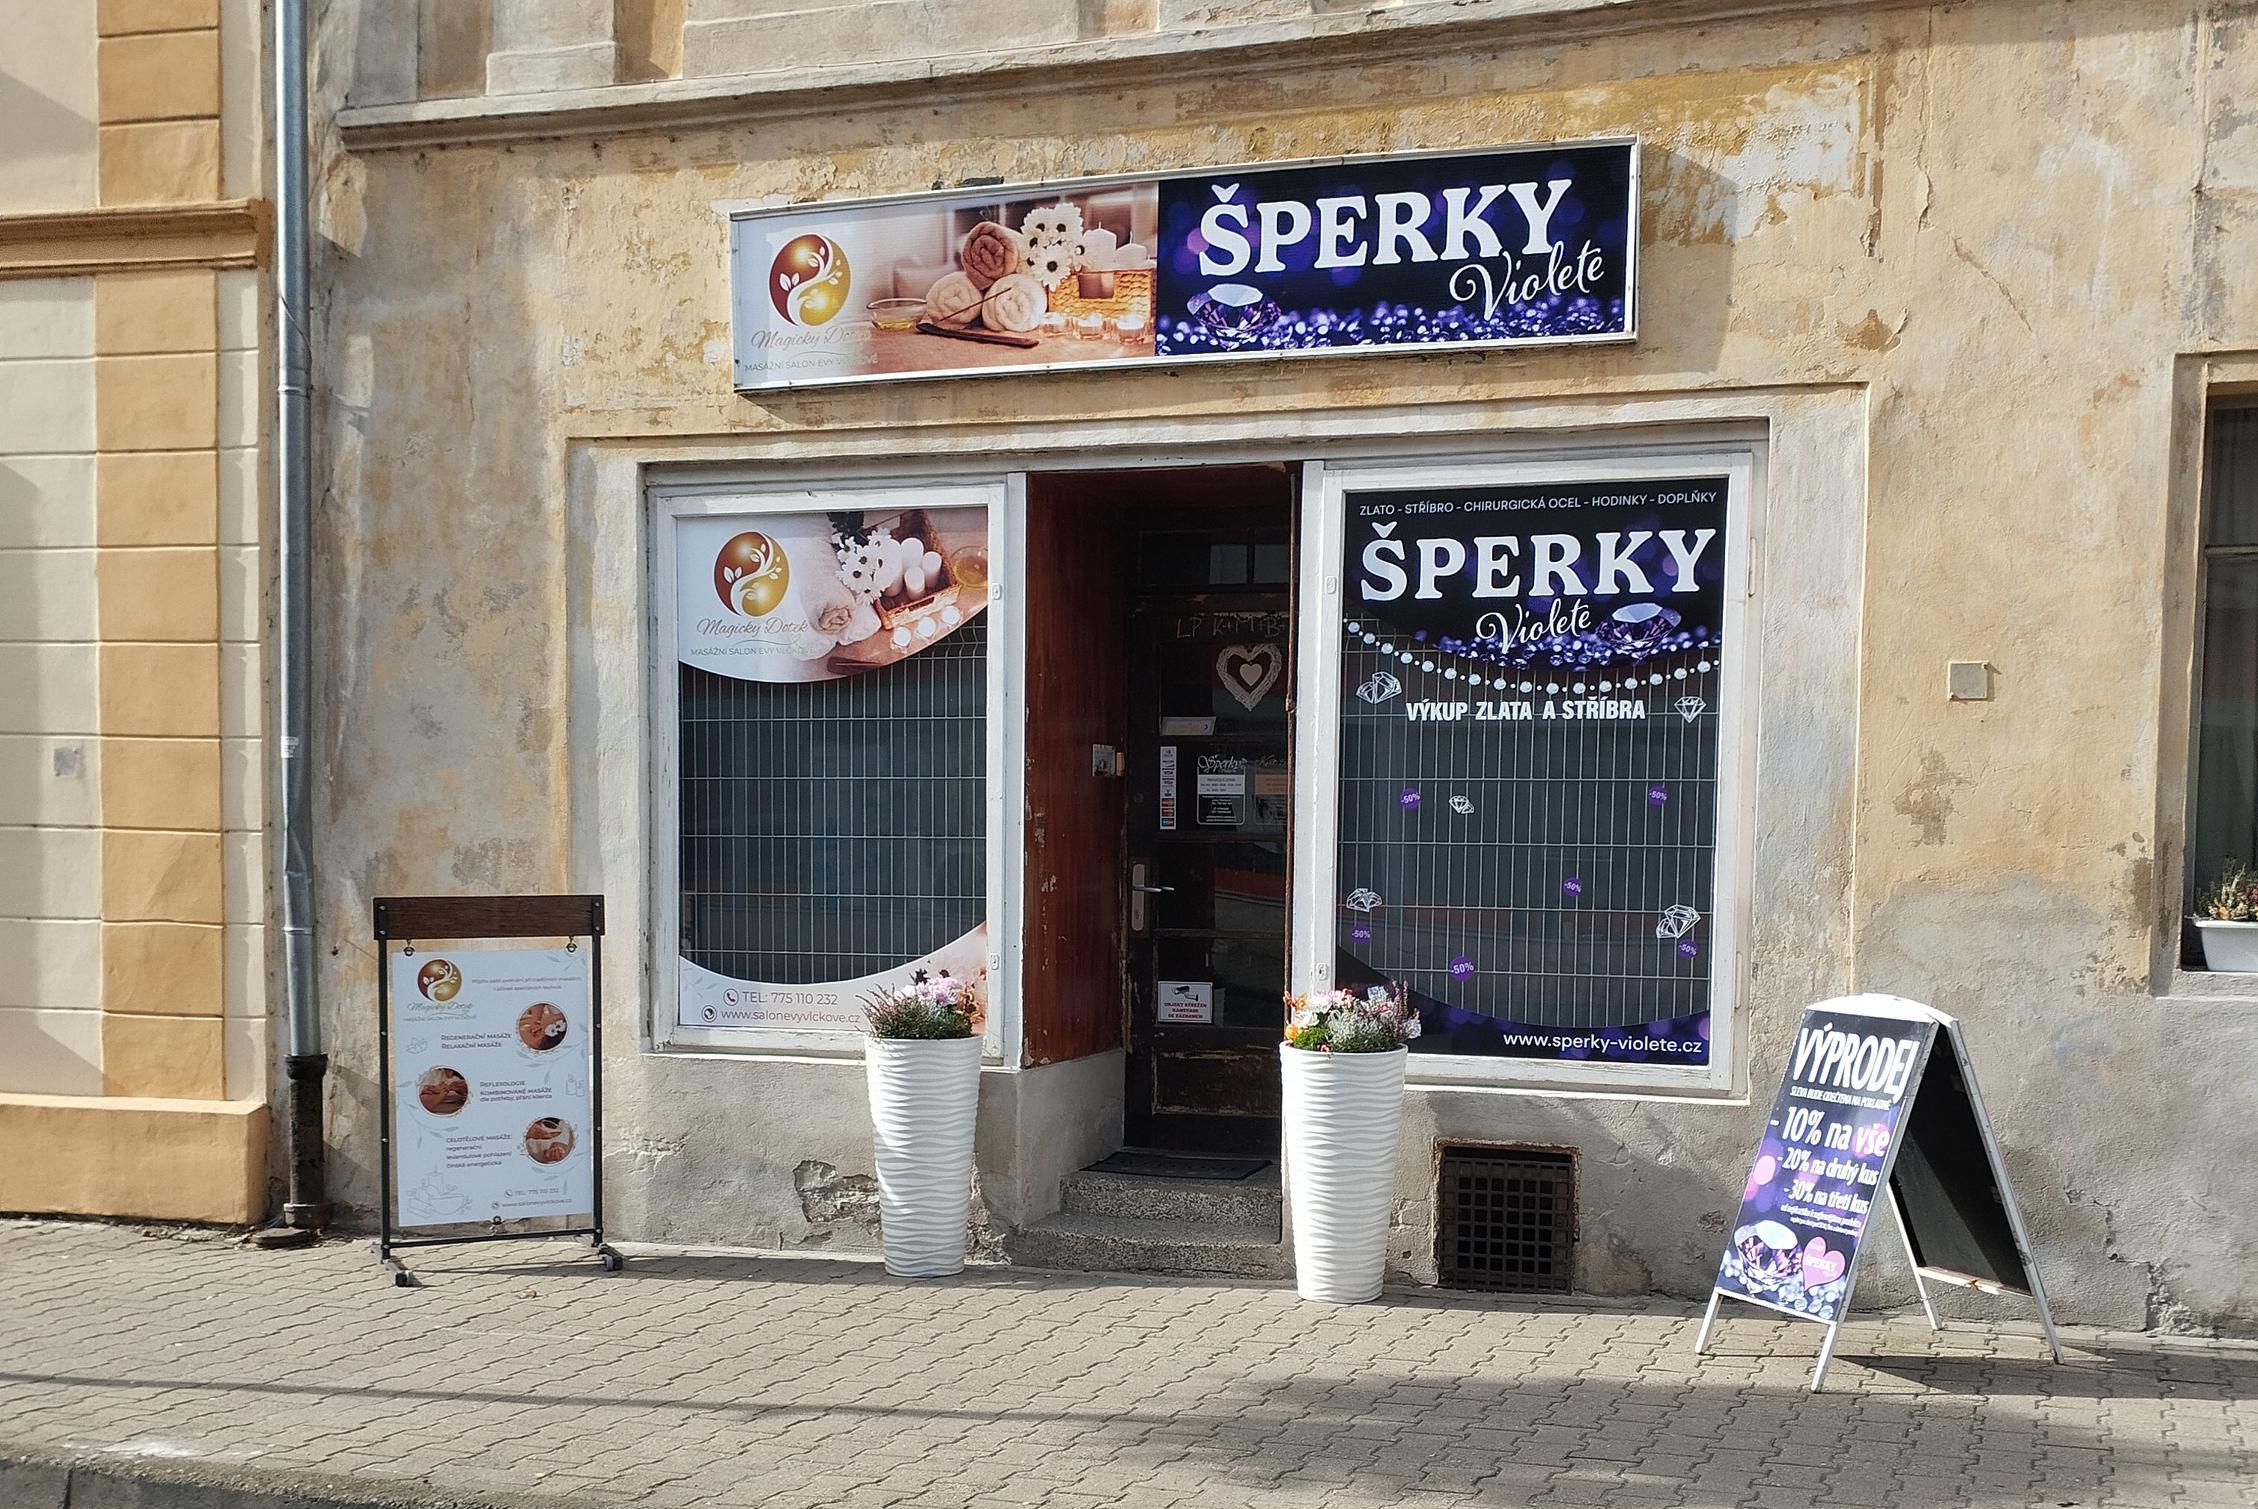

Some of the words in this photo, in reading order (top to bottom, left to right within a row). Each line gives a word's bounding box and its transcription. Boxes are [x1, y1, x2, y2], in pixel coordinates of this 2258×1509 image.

[1198, 179, 1573, 277] ŠPERKY
[1449, 239, 1605, 321] Violete
[785, 360, 815, 370] SALON
[817, 359, 833, 367] EVY
[1359, 504, 1395, 516] ZLATO
[1405, 499, 1454, 515] STŘÍBRO
[1464, 496, 1546, 513] CHIRURGICKÁ
[1548, 497, 1581, 511] OCEL
[1592, 494, 1648, 508] HODINKY
[1657, 490, 1718, 505] DOPLŇKY
[1360, 520, 1717, 602] ŠPERKY
[764, 616, 808, 634] Dotek
[1475, 598, 1591, 656] Violete
[729, 647, 757, 656] SALON
[759, 647, 774, 655] EVY
[1406, 698, 1468, 722] VÝKUP
[1475, 701, 1533, 721] ZLATA
[1542, 701, 1556, 720] A
[1562, 695, 1646, 720] STŘÍBRA
[1400, 793, 1421, 805] -50%
[1649, 790, 1668, 801] -50%
[1563, 881, 1582, 893] -50%
[1351, 929, 1371, 939] -50%
[1678, 943, 1697, 955] -50%
[1450, 961, 1474, 976] -50%
[771, 992, 792, 1005] 775
[796, 992, 813, 1005] 110
[816, 993, 838, 1006] 232
[721, 1009, 861, 1024] www.salonevyvlckove.cz
[1503, 1032, 1702, 1054] www.sperky-violete.cz
[1792, 1021, 1921, 1104] VÝPRODEJ
[1782, 1106, 1825, 1146] 10%
[1823, 1122, 1853, 1151] na
[1855, 1122, 1891, 1157] vše
[1782, 1147, 1812, 1173] 20%
[1810, 1159, 1826, 1176] na
[1825, 1157, 1859, 1186] druhý
[1857, 1162, 1879, 1186] kus
[1813, 1190, 1828, 1206] na
